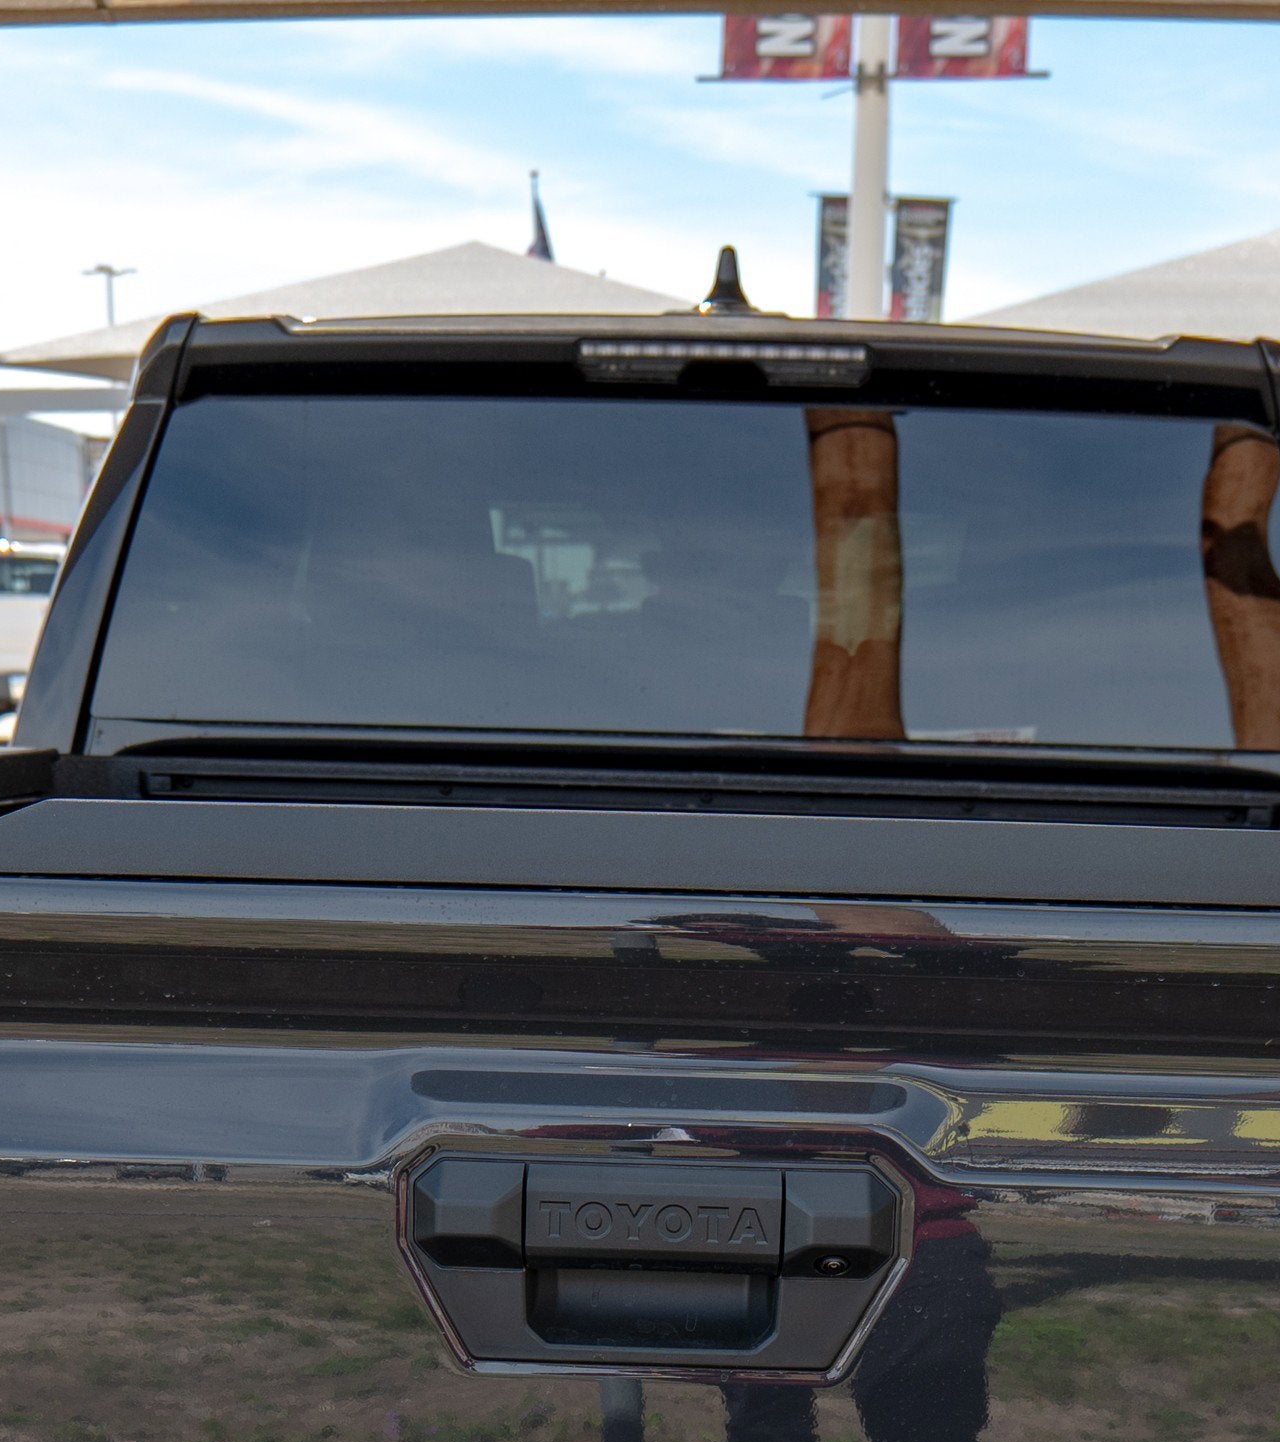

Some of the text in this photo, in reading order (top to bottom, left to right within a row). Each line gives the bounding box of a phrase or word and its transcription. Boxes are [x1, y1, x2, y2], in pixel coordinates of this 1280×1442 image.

[755, 14, 816, 57] N
[929, 14, 989, 57] N
[538, 1200, 769, 1246] TOYOTA
